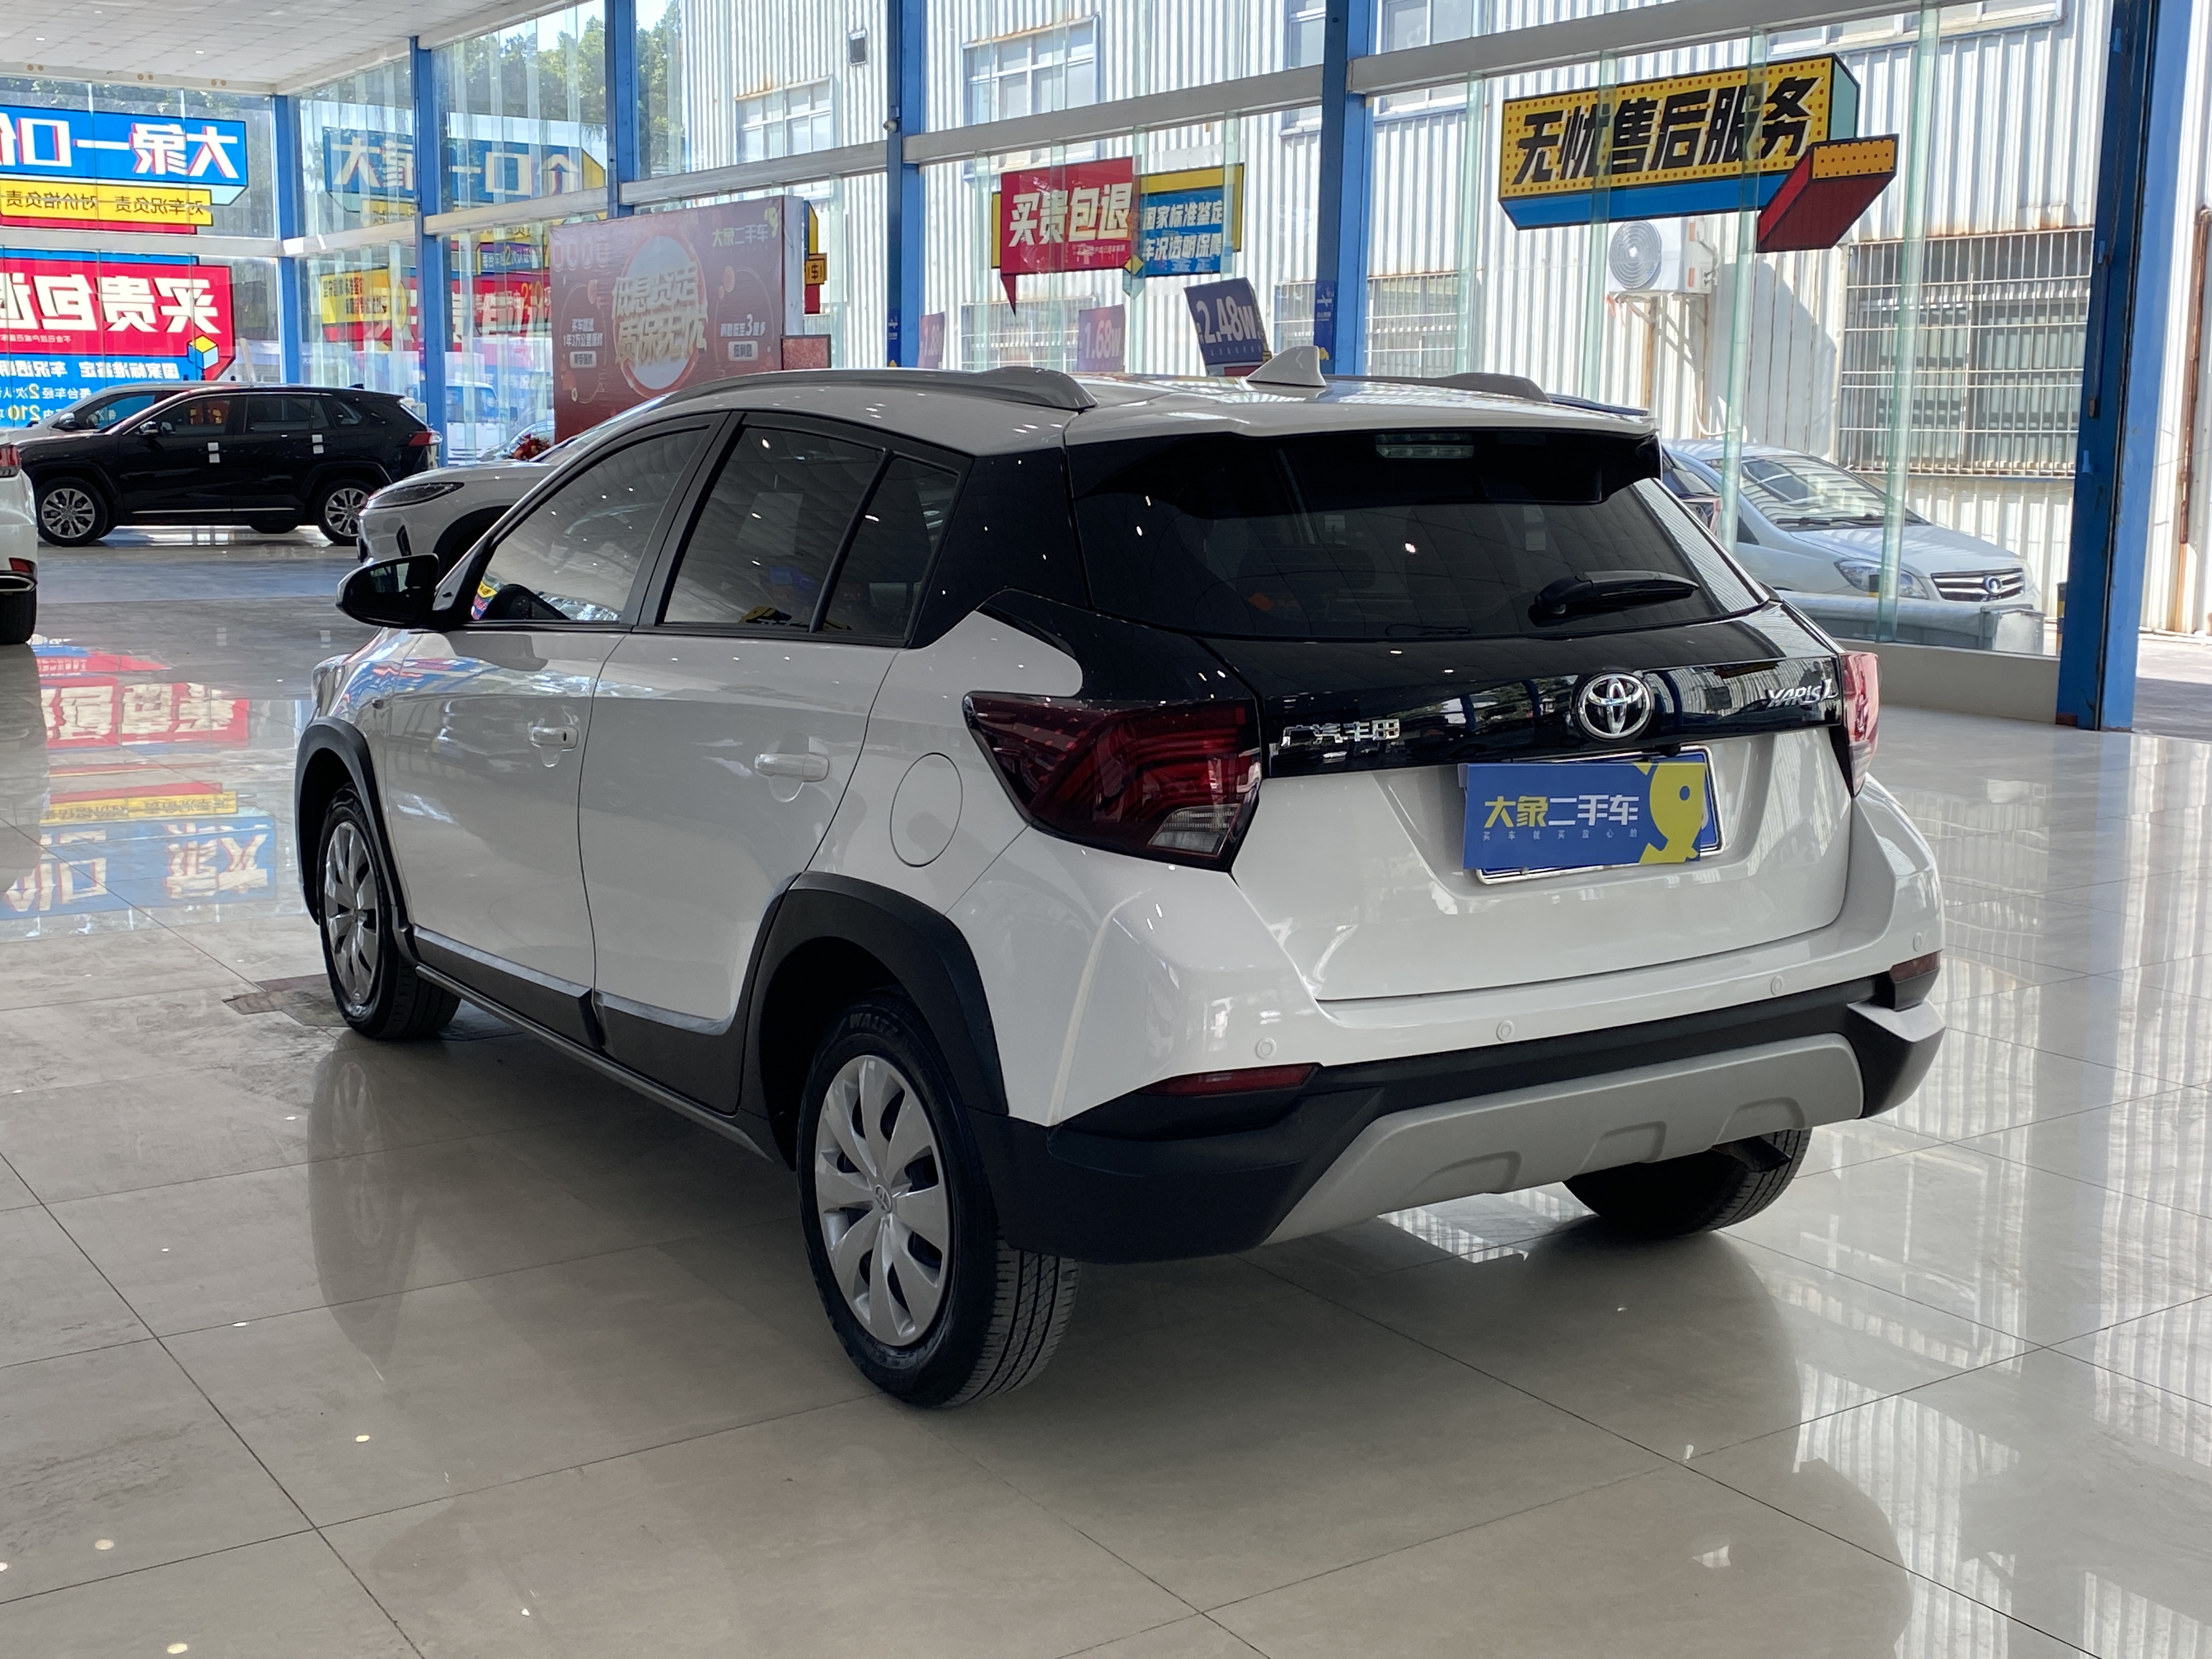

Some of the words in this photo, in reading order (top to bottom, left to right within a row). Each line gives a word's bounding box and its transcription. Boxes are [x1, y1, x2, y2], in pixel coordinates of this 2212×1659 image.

[1511, 75, 1824, 187] 无忧售后服务
[1008, 182, 1133, 247] 买贵包退
[1143, 199, 1223, 230] 国家标准鉴定
[712, 223, 769, 247] 大象二手车
[1142, 233, 1222, 261] 车况透明保障
[1280, 718, 1400, 747] 广汽丰田
[1483, 794, 1640, 828] 大象二手车
[1482, 828, 1638, 842] 买车就买放心的
